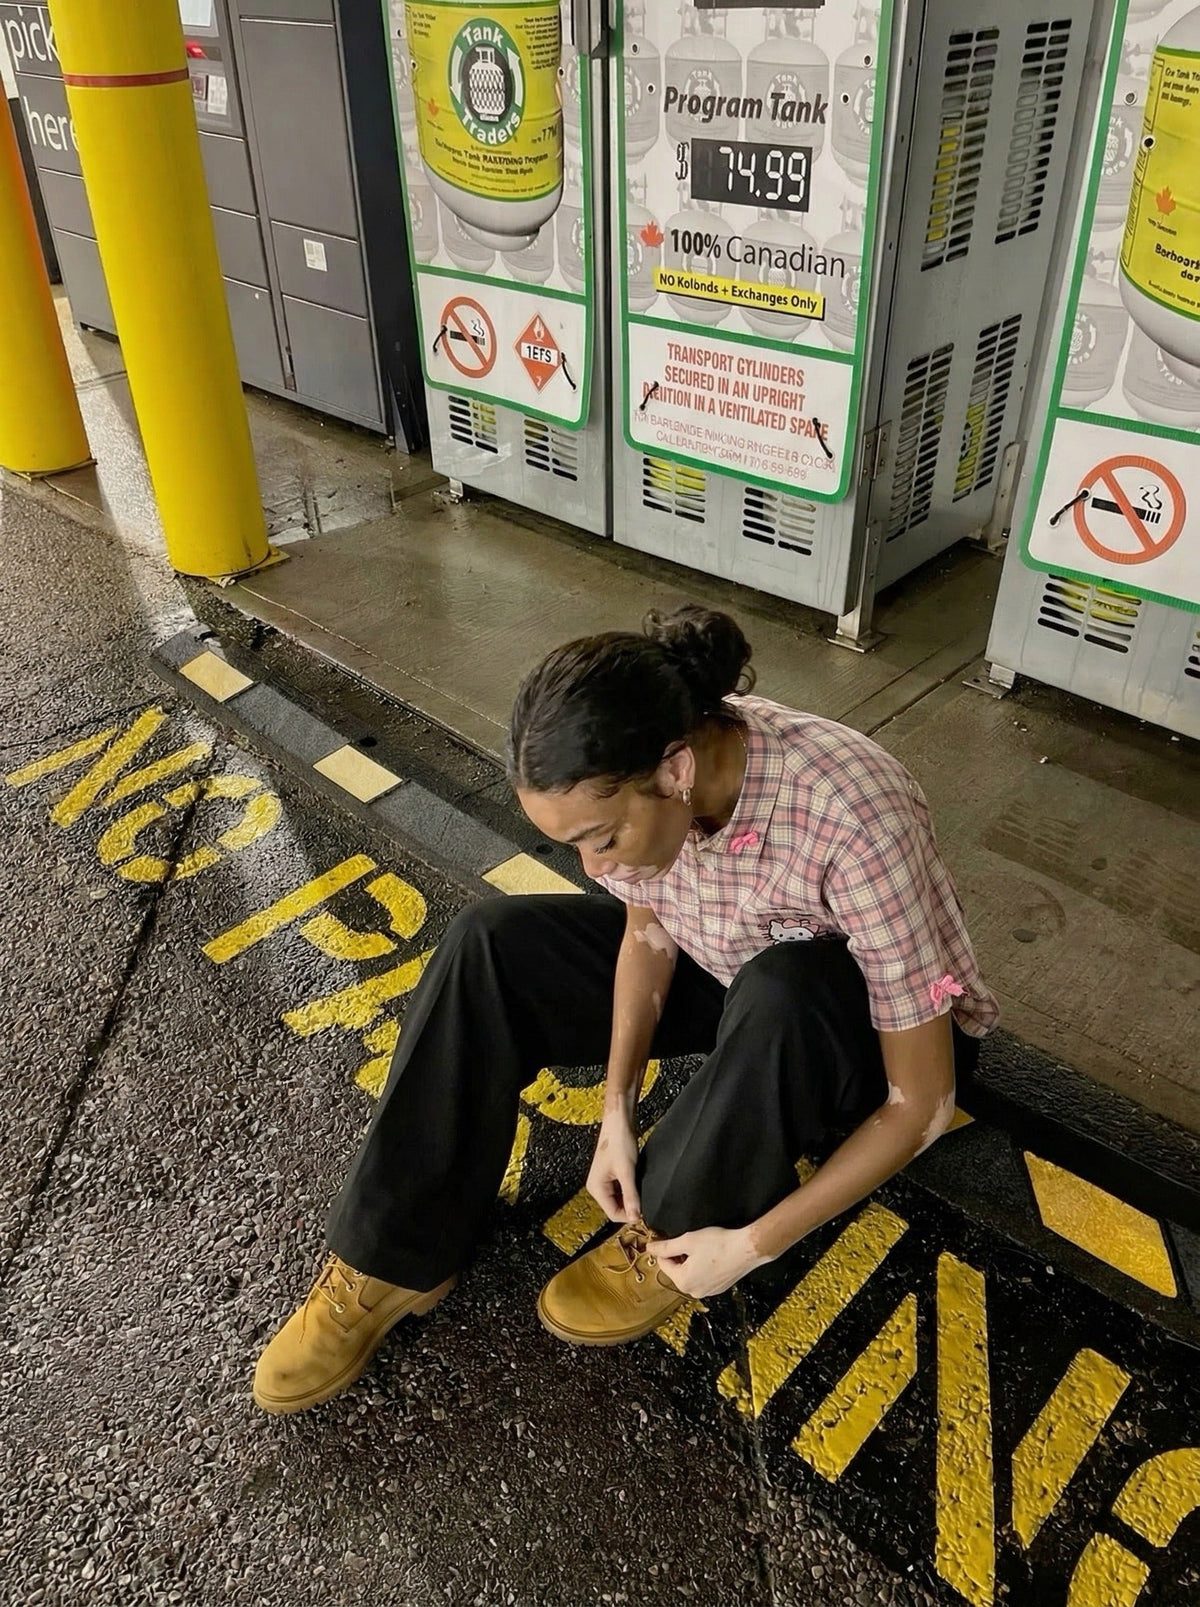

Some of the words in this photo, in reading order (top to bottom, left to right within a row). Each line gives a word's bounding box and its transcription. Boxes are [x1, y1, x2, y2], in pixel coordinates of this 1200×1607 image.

[463, 26, 504, 48] Tank
[664, 86, 763, 123] Program
[771, 92, 829, 124] Tank
[462, 108, 521, 145] Traders
[719, 146, 807, 203] 74.99
[671, 229, 721, 259] 100%
[727, 236, 845, 278] Canadian
[660, 273, 675, 286] NO
[731, 285, 788, 307] Exchanges
[790, 294, 818, 313] Only
[667, 343, 734, 372] TRANSPORT
[664, 365, 715, 391] SECURED
[718, 377, 731, 395] IN
[733, 382, 748, 401] AN
[752, 384, 806, 412] UPRIGHT
[694, 393, 705, 411] IN
[708, 398, 716, 416] A
[719, 399, 787, 431] VENTILATED
[5, 704, 284, 883] NO
